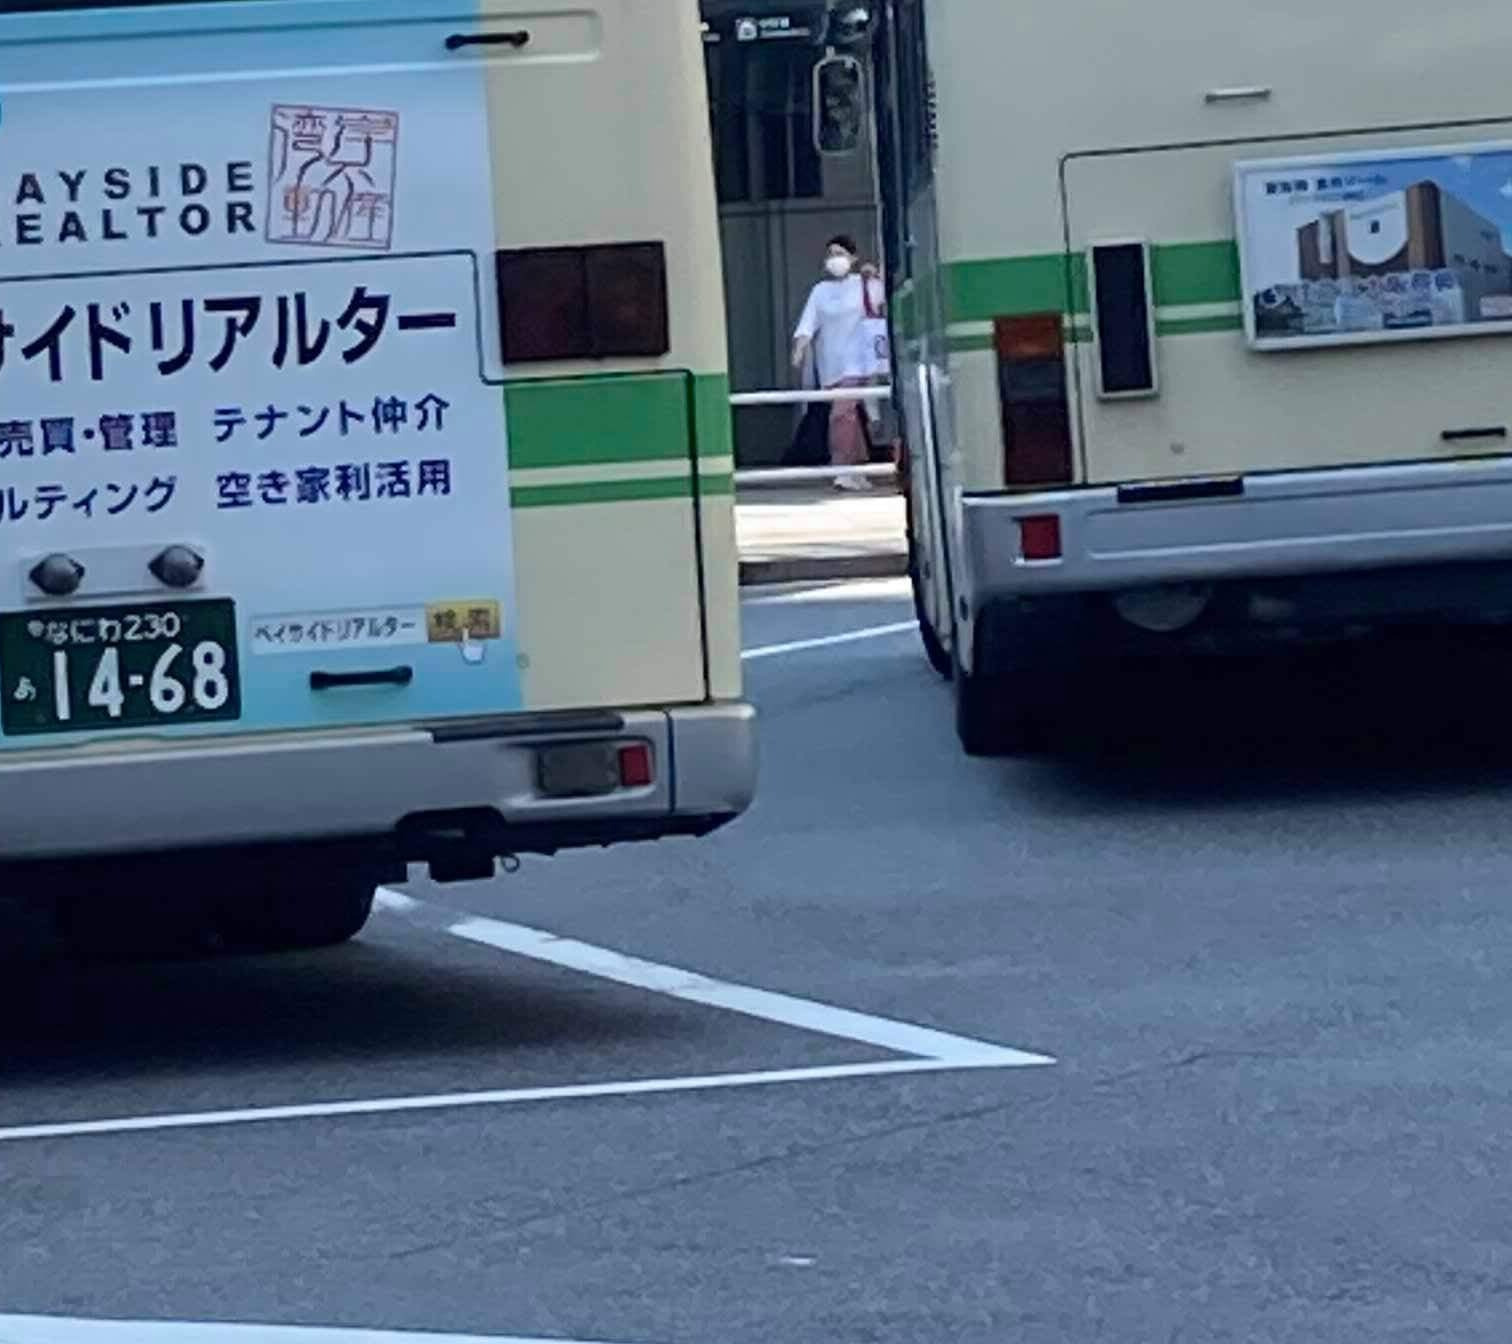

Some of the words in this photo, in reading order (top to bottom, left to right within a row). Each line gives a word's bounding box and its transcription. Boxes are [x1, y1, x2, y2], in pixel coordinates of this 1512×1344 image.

[212, 393, 450, 446] テナント仲介
[216, 458, 452, 512] 空き家利活用
[53, 640, 230, 722] 14-68
